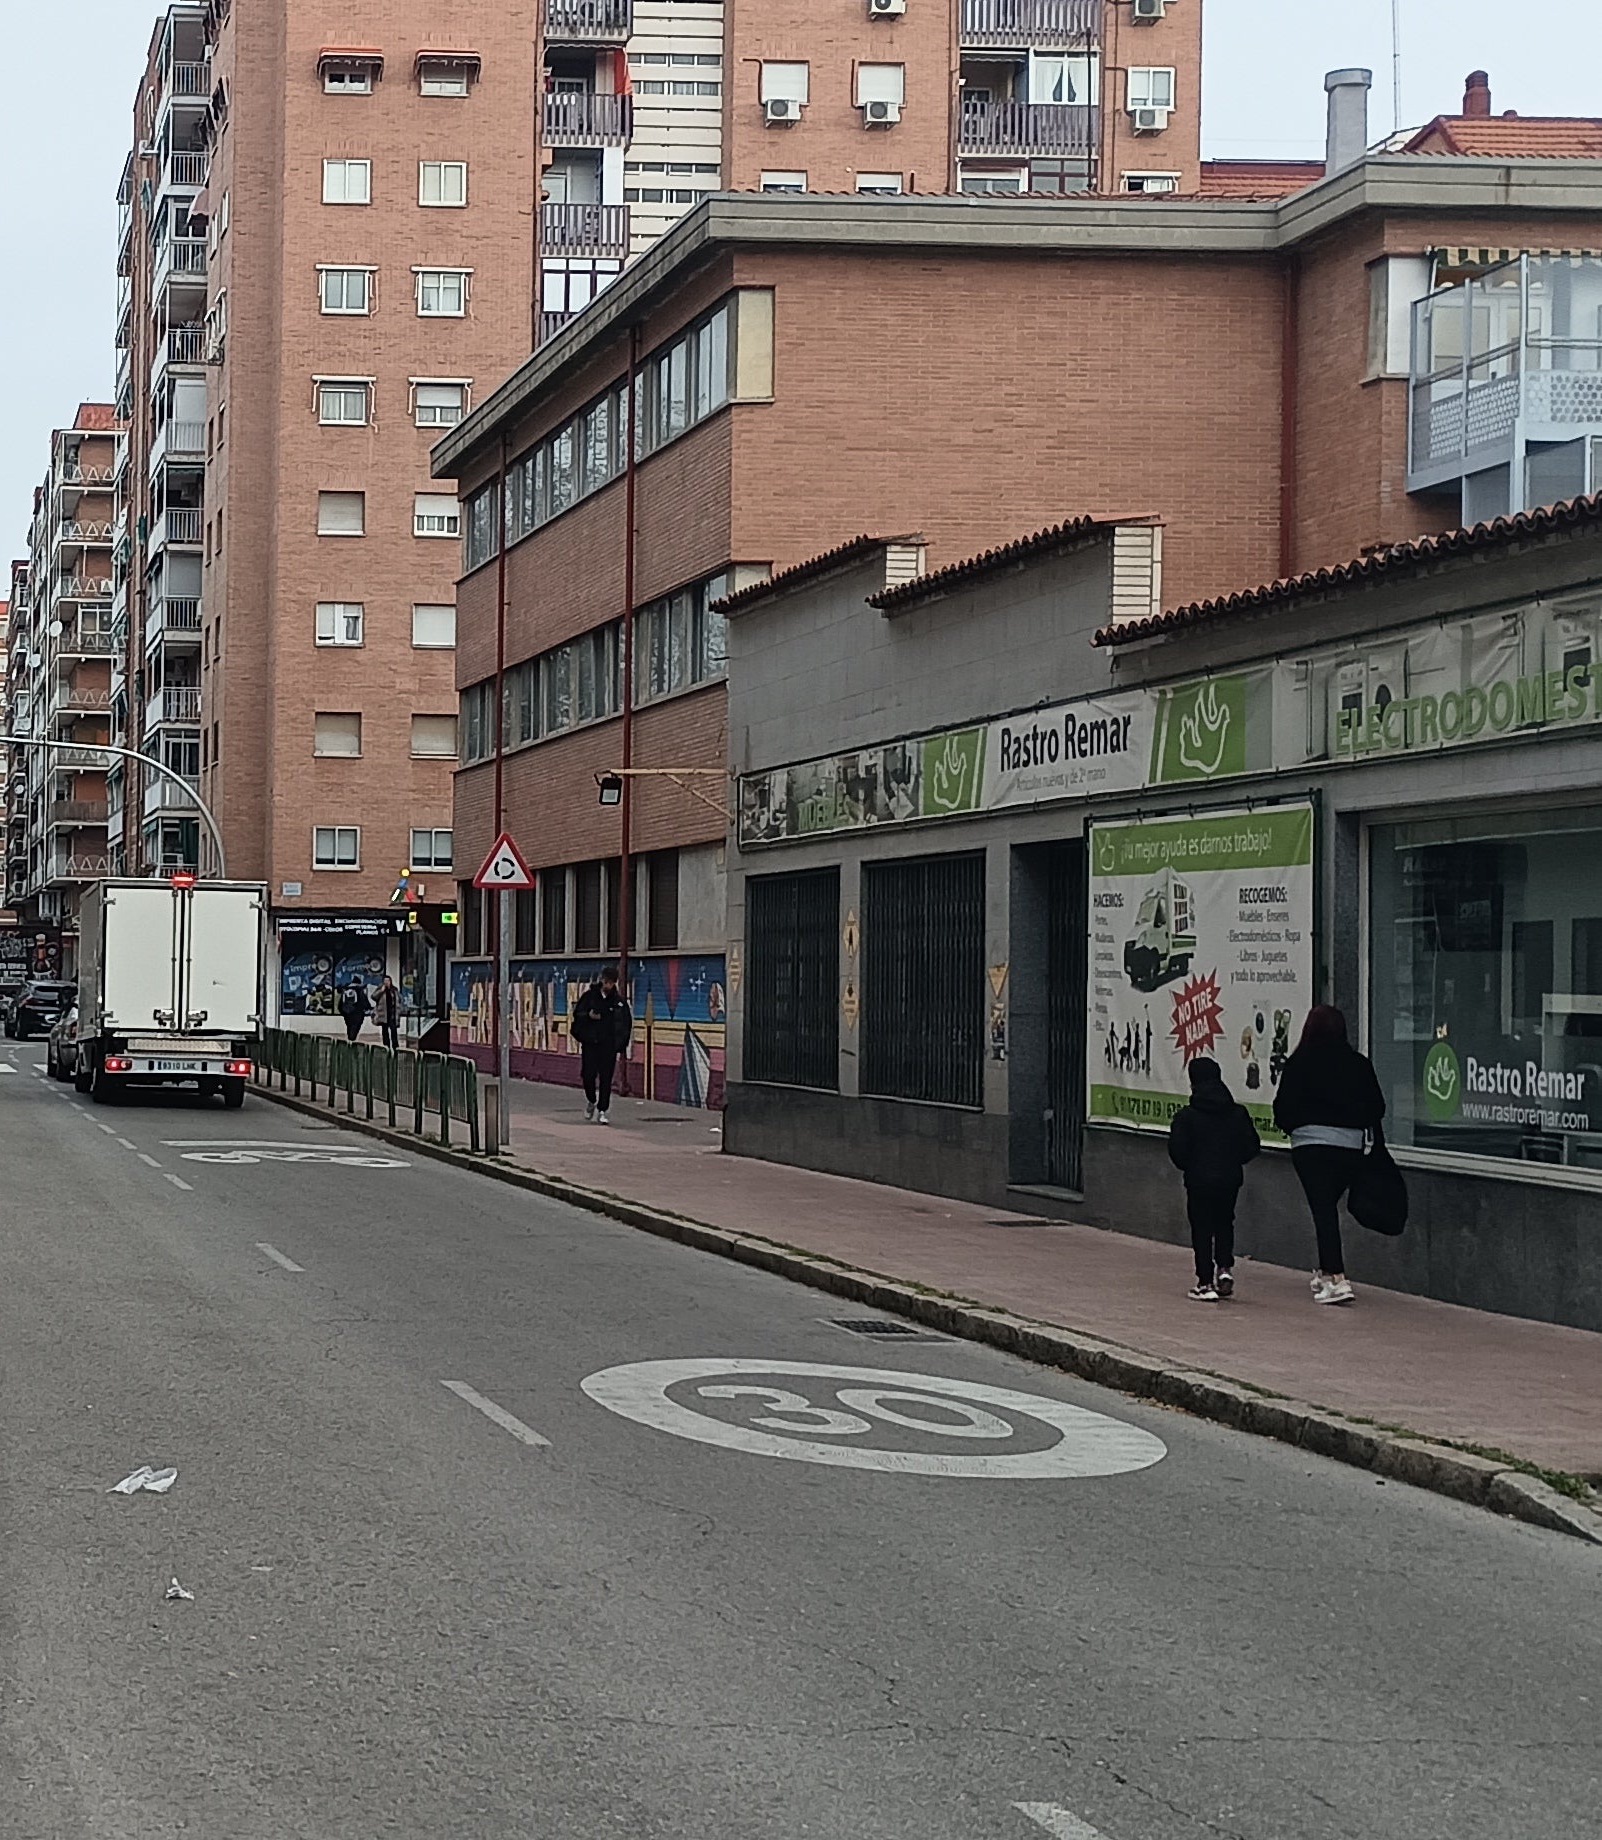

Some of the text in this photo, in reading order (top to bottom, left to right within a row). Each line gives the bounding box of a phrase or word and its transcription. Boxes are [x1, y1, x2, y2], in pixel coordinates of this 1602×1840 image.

[1000, 713, 1131, 772] Rastro Remar
[1134, 837, 1159, 864] mejor
[1161, 832, 1187, 862] ayuda
[1189, 838, 1198, 855] es
[1200, 831, 1232, 855] darnos
[1234, 827, 1272, 857] trabajo!
[1093, 893, 1124, 908] HACEMOS:
[1239, 886, 1288, 904] RECOGEMOS:
[1284, 928, 1301, 944] Ropa
[1178, 986, 1213, 1026] NO TIRE
[1185, 1015, 1210, 1046] NADA
[1466, 1056, 1585, 1101] Rastro Remar
[1461, 1102, 1590, 1131] www.rastroremar.com
[697, 1383, 1014, 1438] 30
